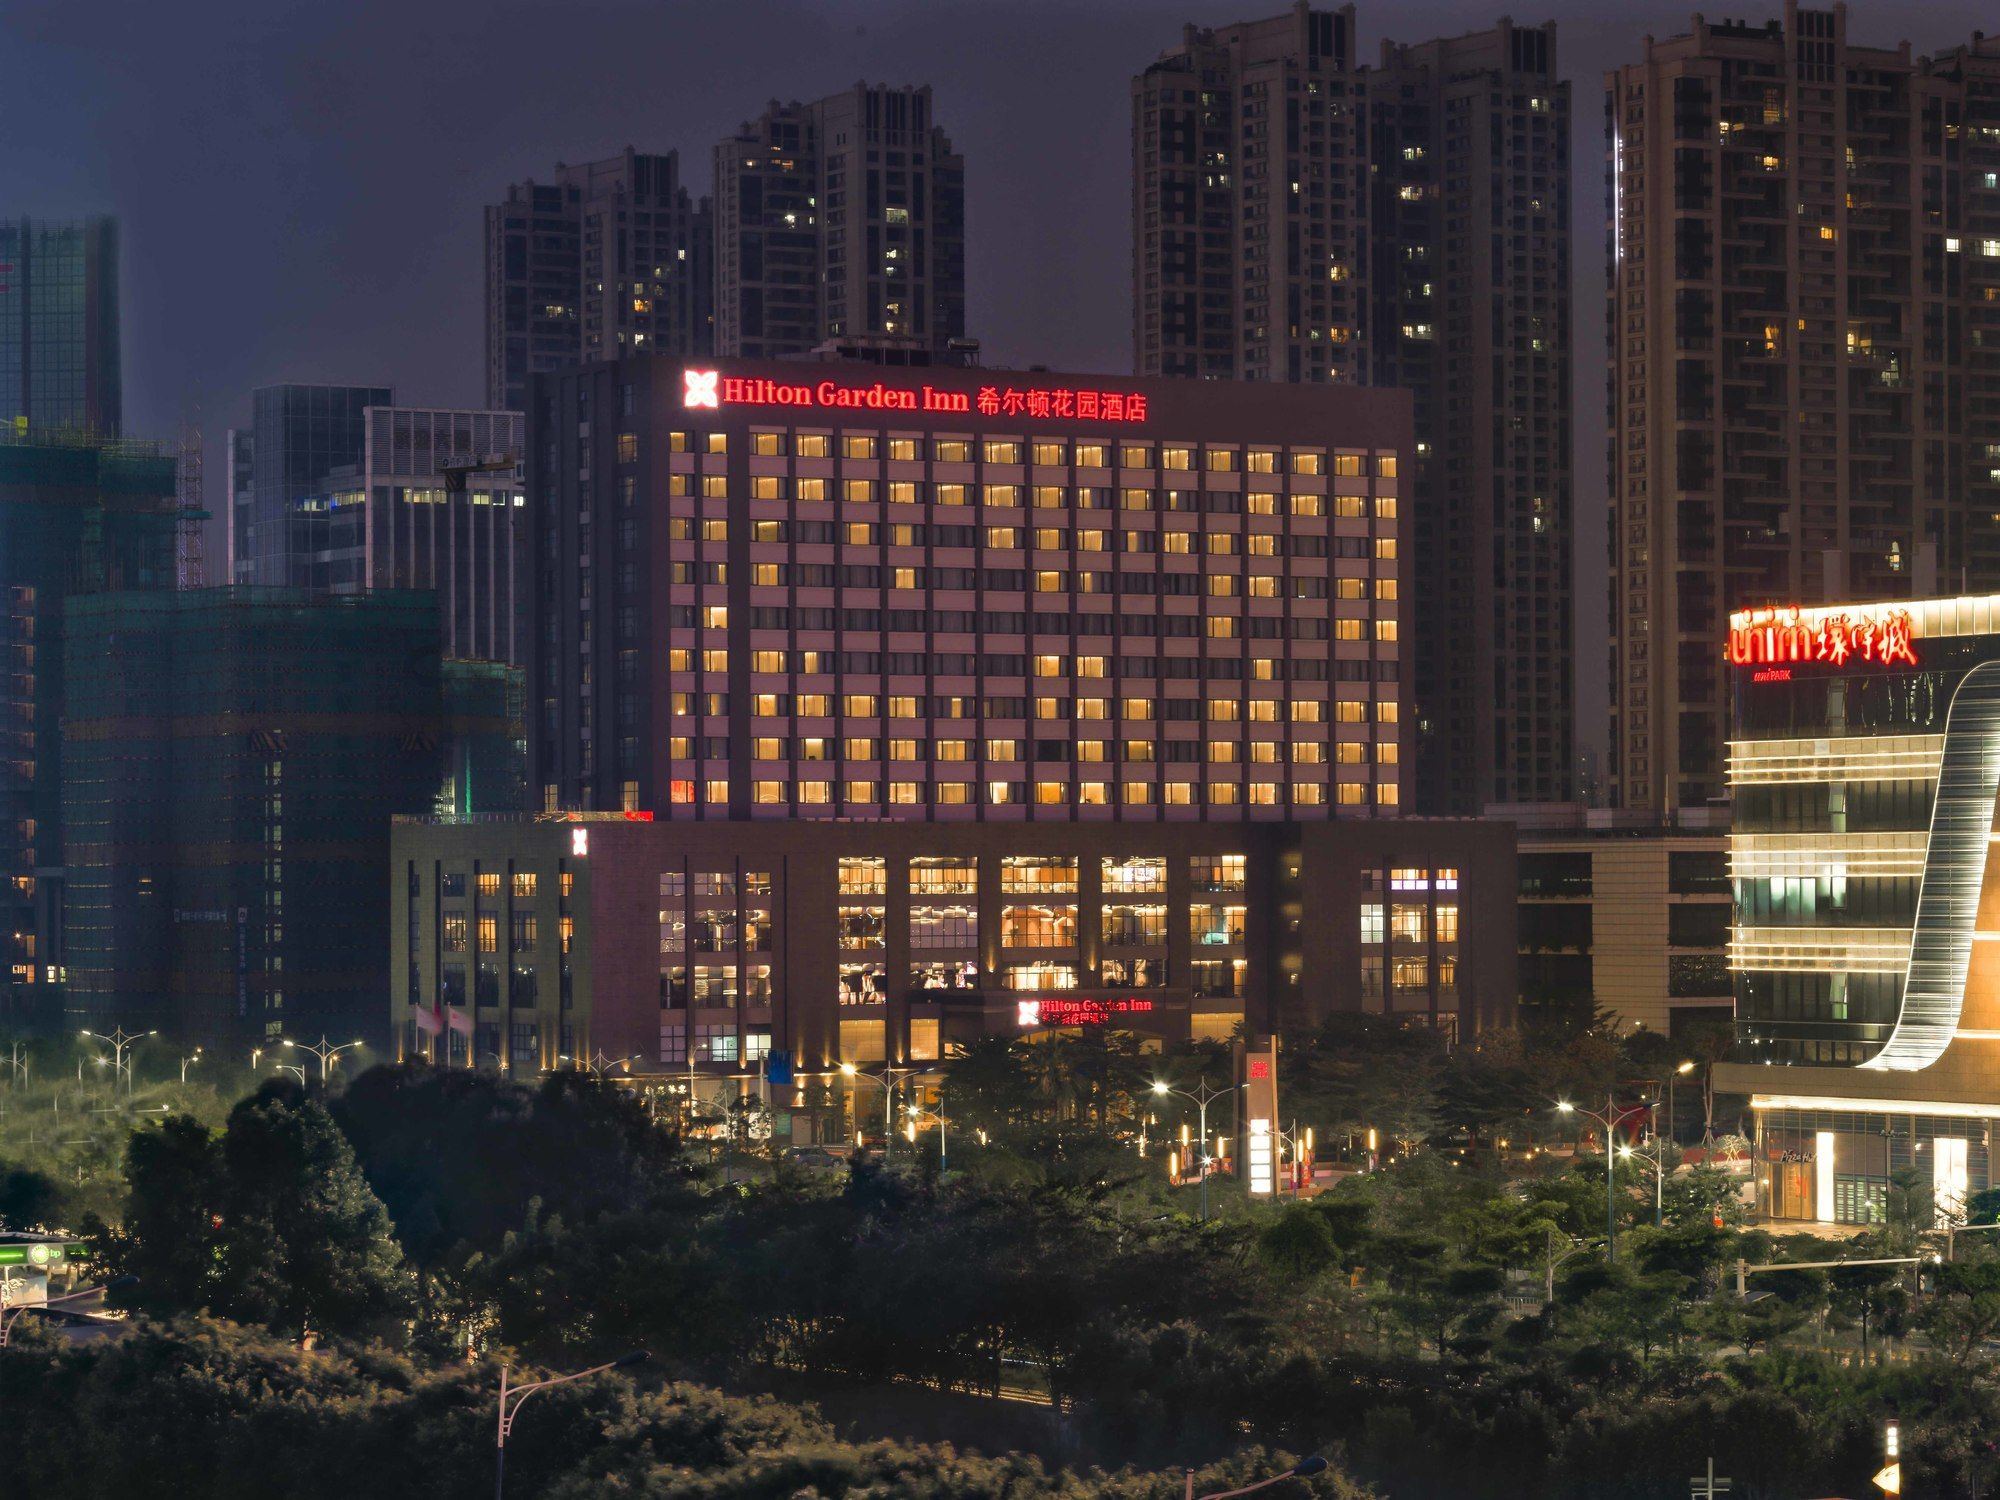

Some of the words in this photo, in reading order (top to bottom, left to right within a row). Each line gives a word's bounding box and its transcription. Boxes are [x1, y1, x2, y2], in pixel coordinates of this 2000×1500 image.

[723, 378, 812, 405] Hilton
[817, 381, 916, 409] Garden
[922, 386, 969, 412] Inn
[977, 387, 1147, 422] 希尔顿花园酒店
[1040, 1000, 1080, 1012] Hilton
[1130, 999, 1152, 1011] Inn
[1781, 1149, 1802, 1163] Pizza
[50, 1249, 61, 1259] bp
